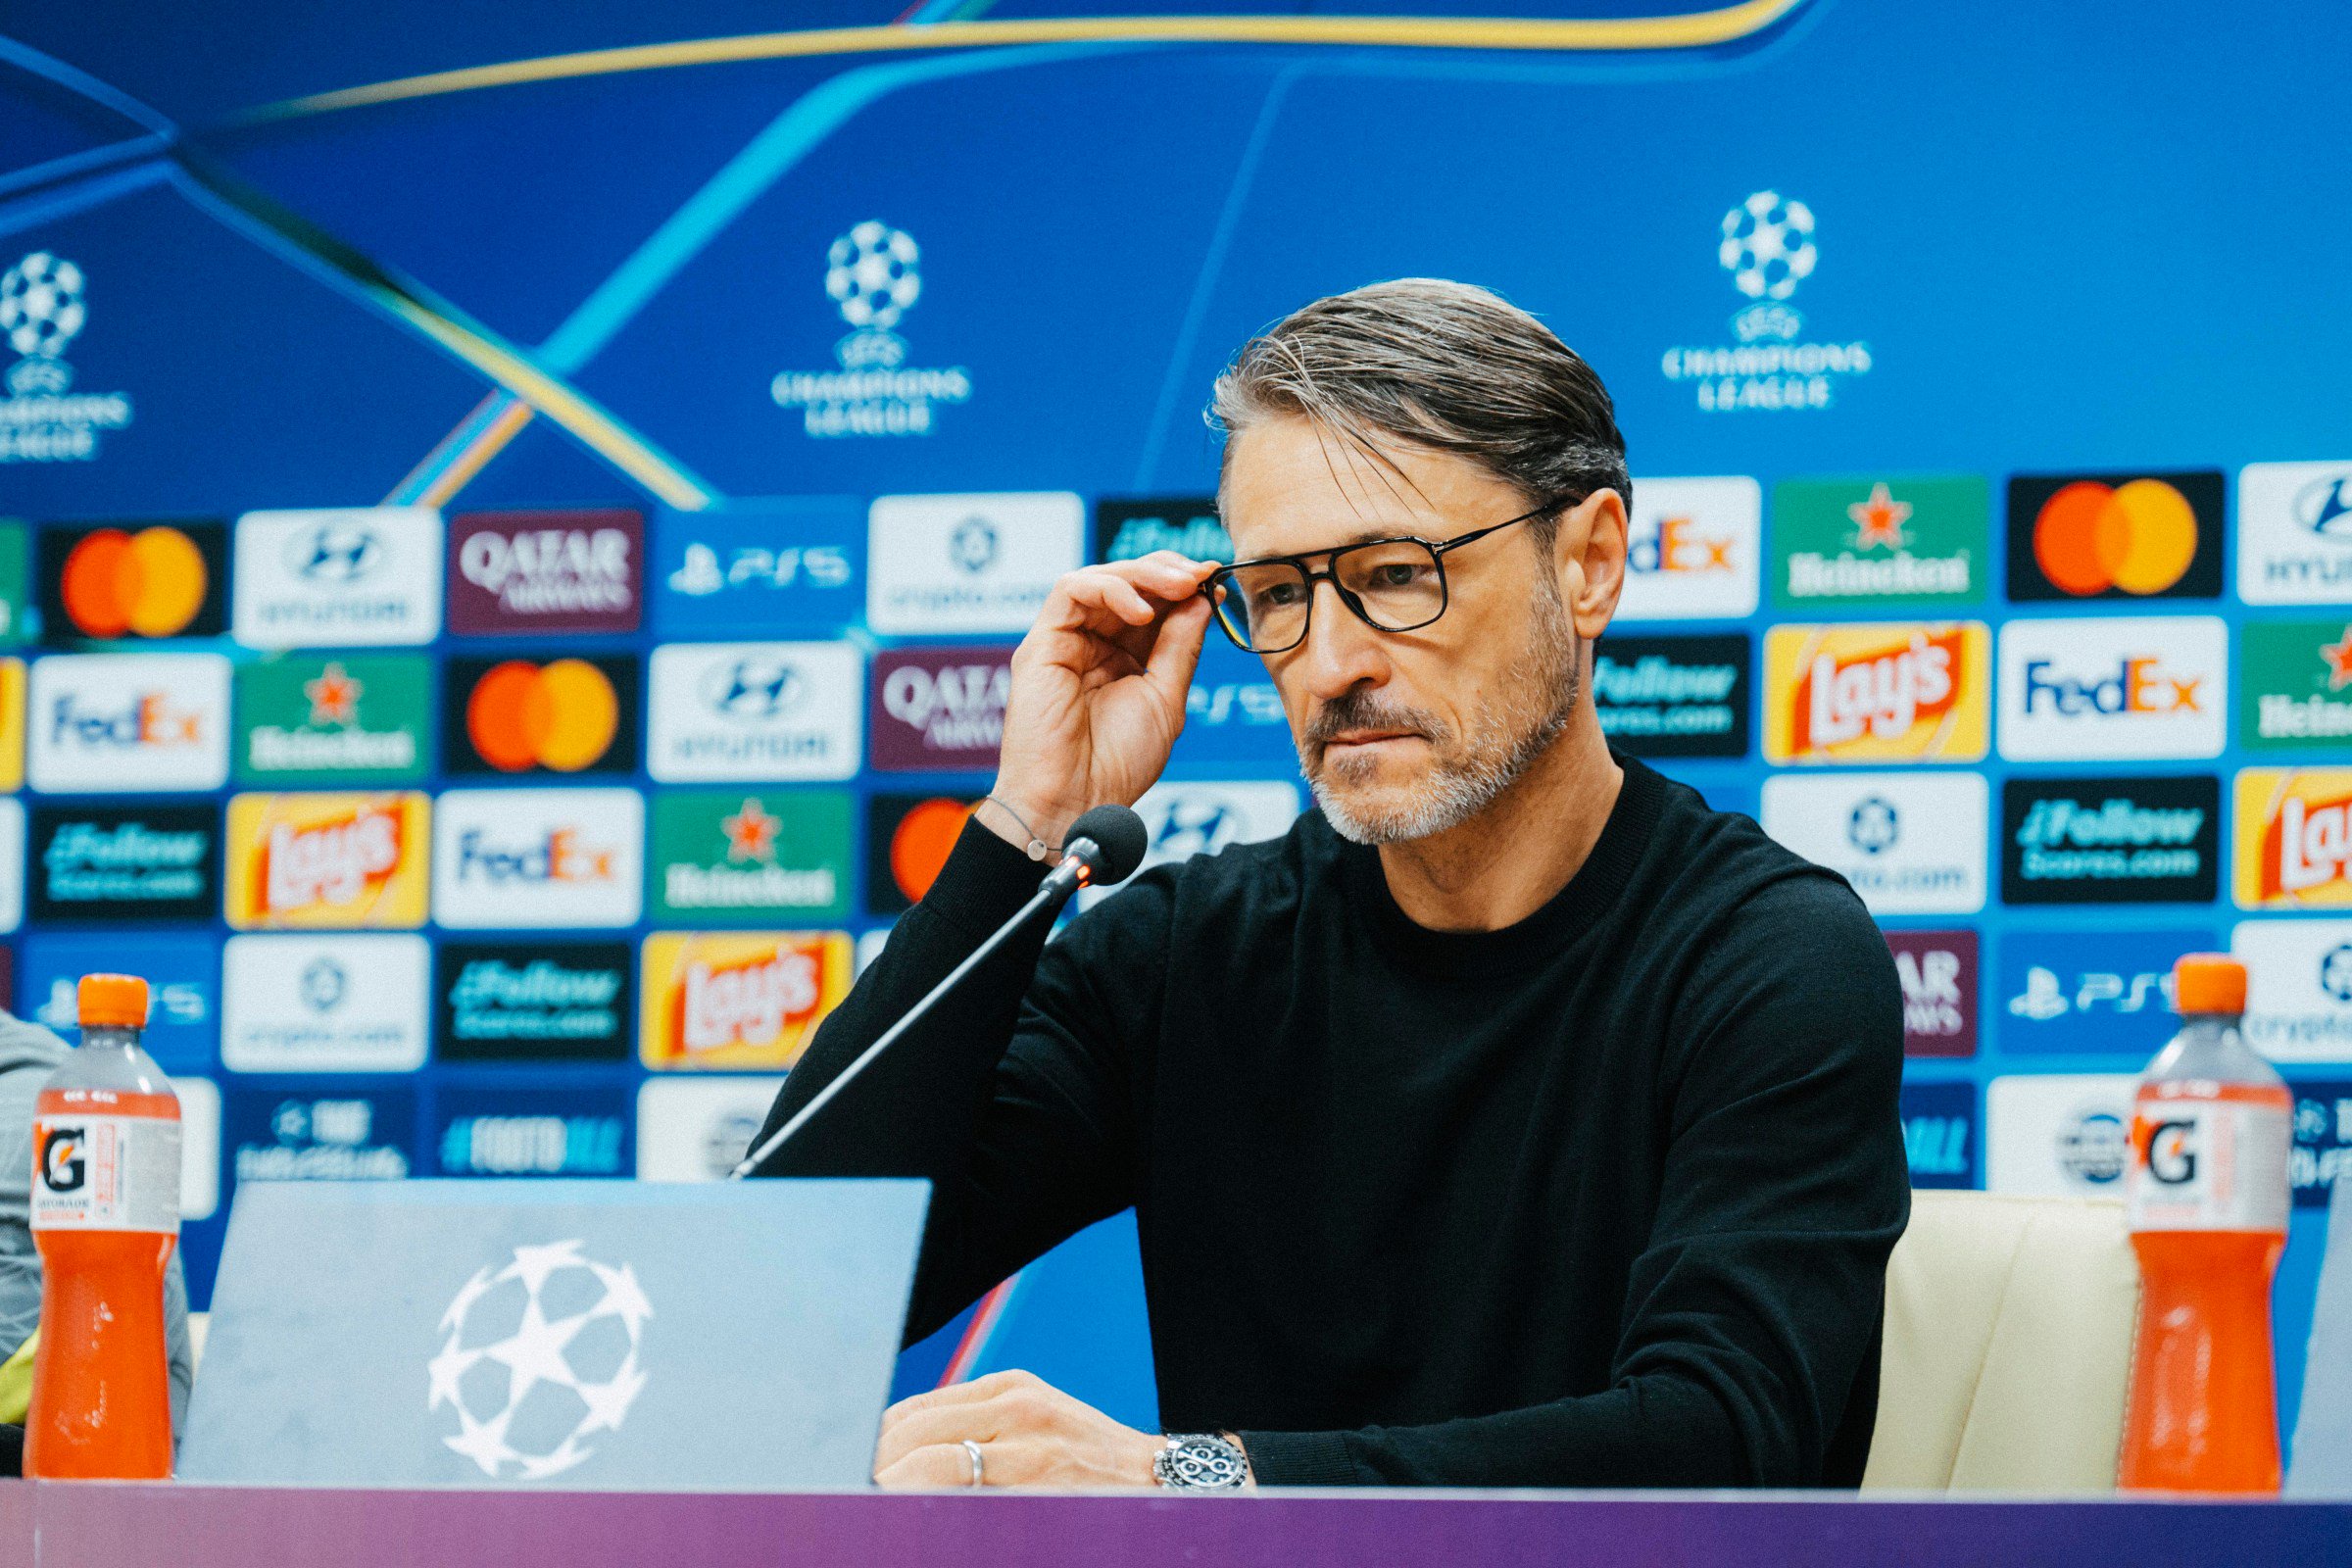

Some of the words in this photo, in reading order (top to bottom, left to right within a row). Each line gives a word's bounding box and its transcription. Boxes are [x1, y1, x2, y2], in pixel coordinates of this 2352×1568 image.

[770, 367, 970, 406] CHAMPIONS
[1661, 343, 1871, 380] CHAMPIONS
[805, 399, 931, 436] LEAGUE
[1697, 375, 1830, 412] LEAGUE
[460, 528, 630, 594] QATAR
[1629, 517, 1733, 574] dEx
[1788, 549, 1970, 597] Heineken
[1809, 632, 1952, 744] Lay's
[2025, 655, 2200, 715] FedEx
[51, 692, 203, 748] FedEx
[248, 724, 416, 770] Heineken
[268, 805, 398, 912] Lay's
[459, 826, 617, 883] FedEx
[664, 861, 837, 908] Heineken
[684, 947, 819, 1050] Lay's
[42, 1128, 85, 1194] G
[2148, 1120, 2196, 1185] G
